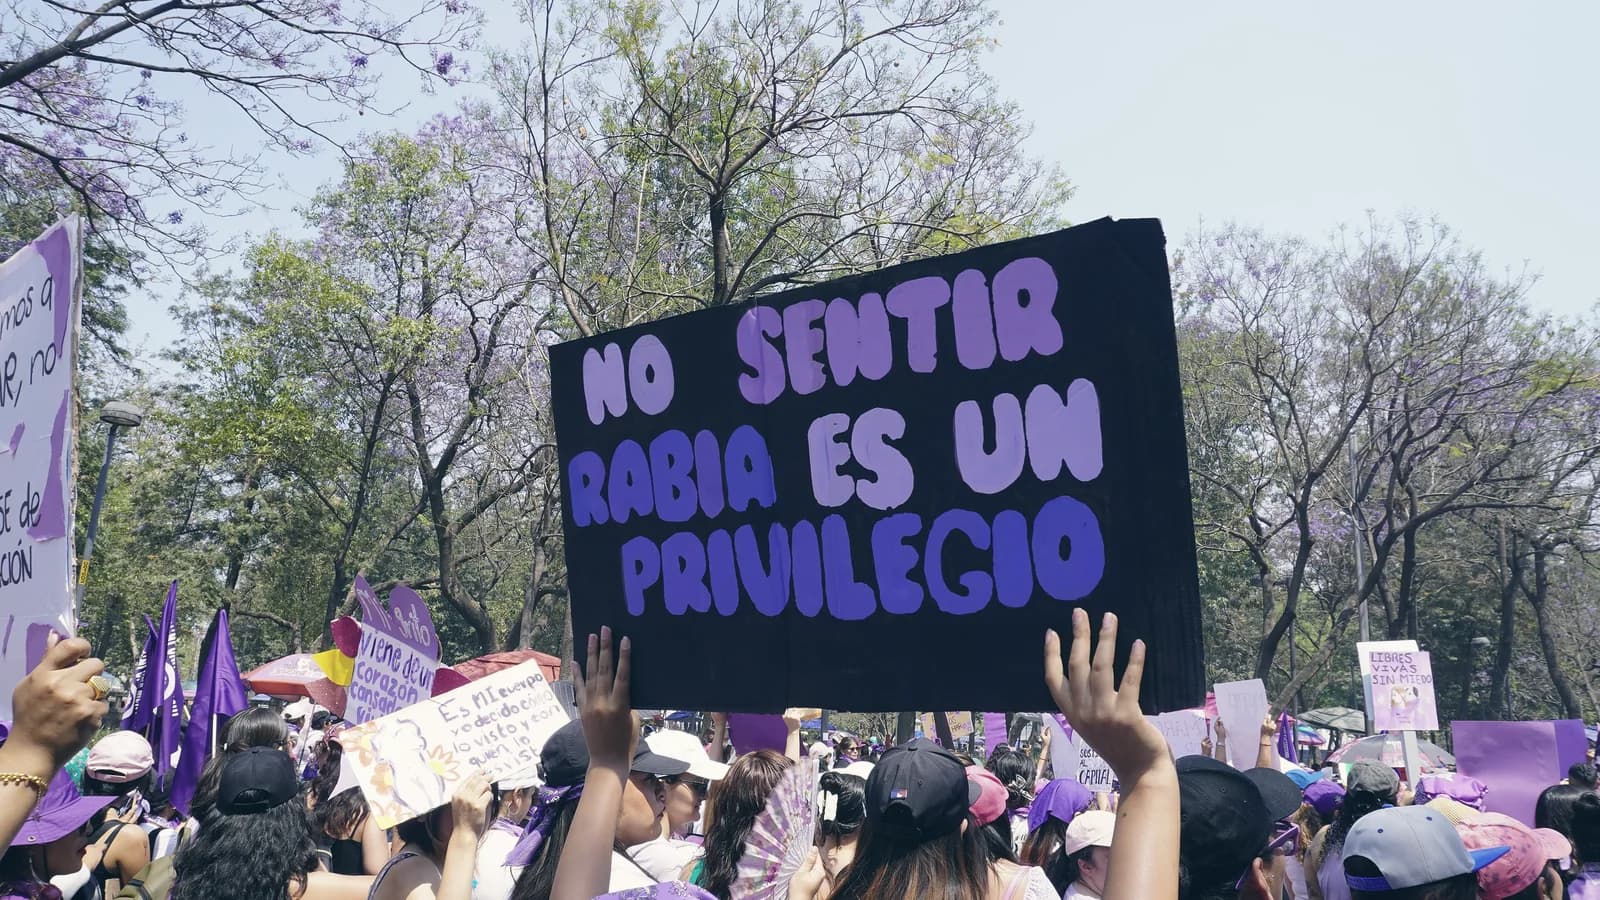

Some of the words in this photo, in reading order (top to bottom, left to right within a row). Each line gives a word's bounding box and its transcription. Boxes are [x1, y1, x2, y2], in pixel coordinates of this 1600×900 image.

[41, 272, 53, 311] a
[583, 334, 675, 425] NO
[736, 257, 1063, 405] SENTIR
[30, 343, 56, 384] no
[568, 425, 776, 527] RABIA
[808, 408, 914, 510] ES
[954, 378, 1104, 494] UN
[20, 481, 42, 528] de
[621, 496, 1105, 620] PRIVILEGIO
[1371, 652, 1413, 664] LIBRES
[1372, 664, 1418, 674] VIVAS
[1372, 674, 1396, 686] SIN
[1400, 674, 1433, 686] MIEDO
[438, 697, 471, 723] Es
